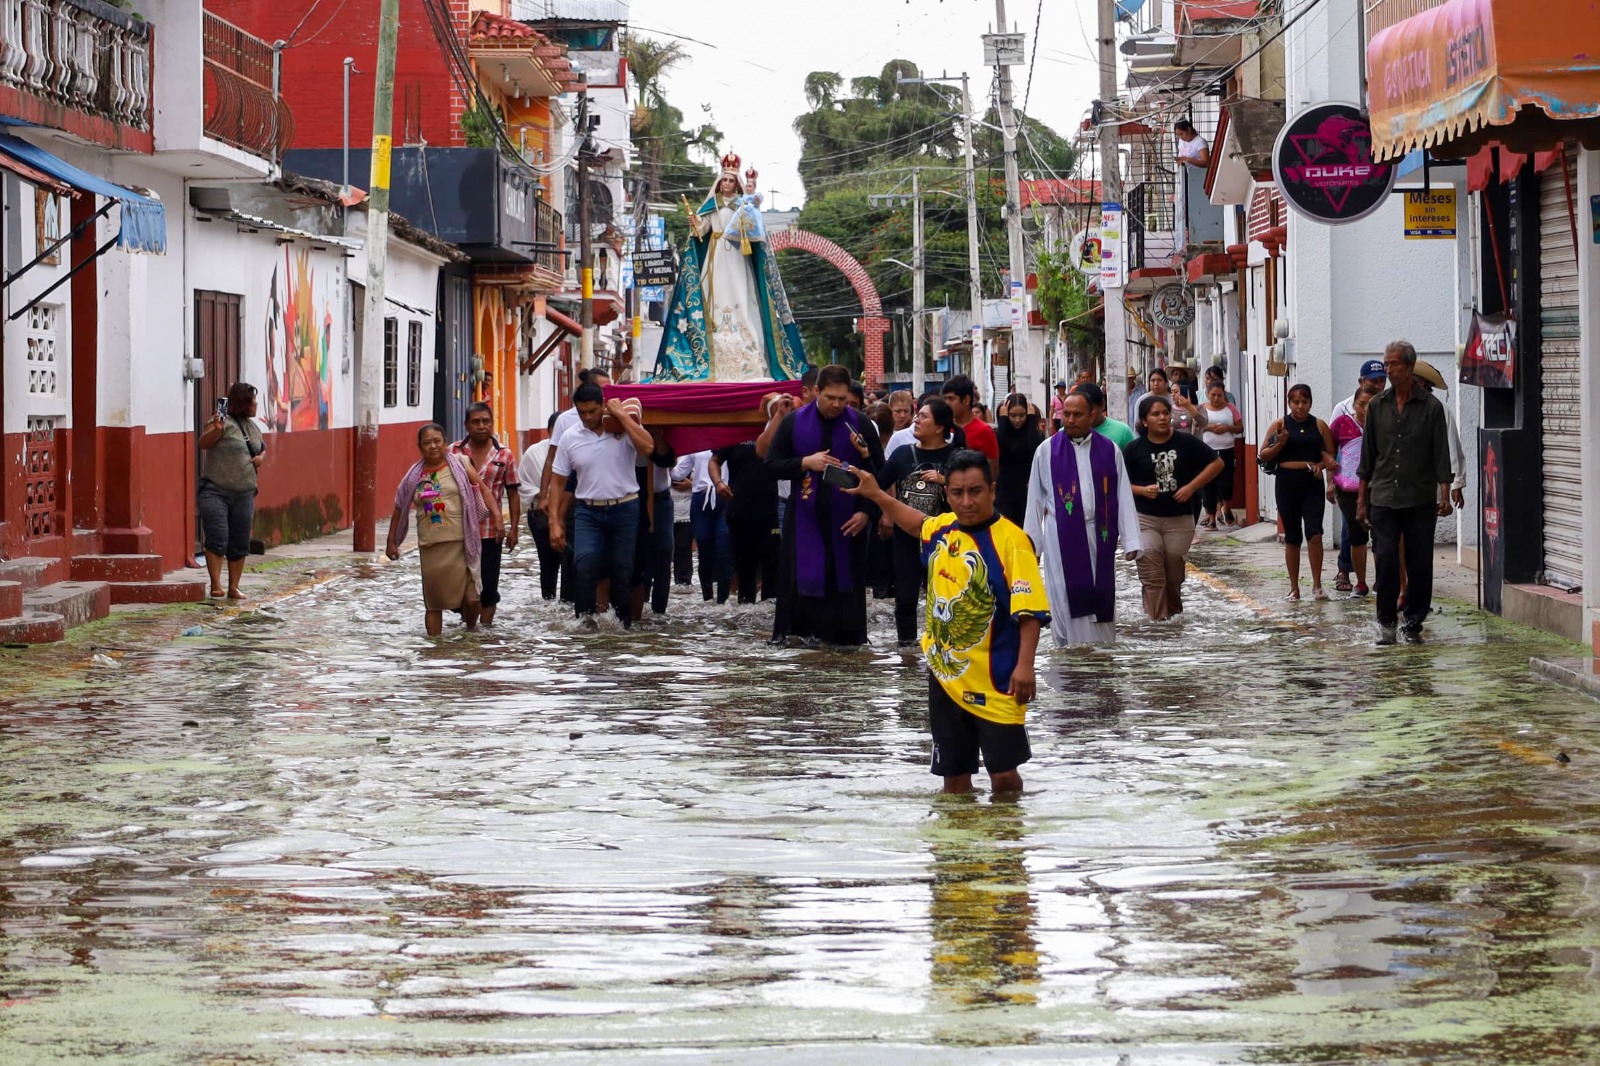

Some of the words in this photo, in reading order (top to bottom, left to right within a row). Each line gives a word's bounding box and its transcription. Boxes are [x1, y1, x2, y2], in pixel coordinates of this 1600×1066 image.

[1304, 165, 1371, 177] DUKE
[1409, 191, 1452, 204] Meses
[1424, 206, 1436, 214] sin
[644, 259, 665, 268] LIBROS
[648, 267, 654, 275] Y
[653, 266, 673, 274] MEZCAL
